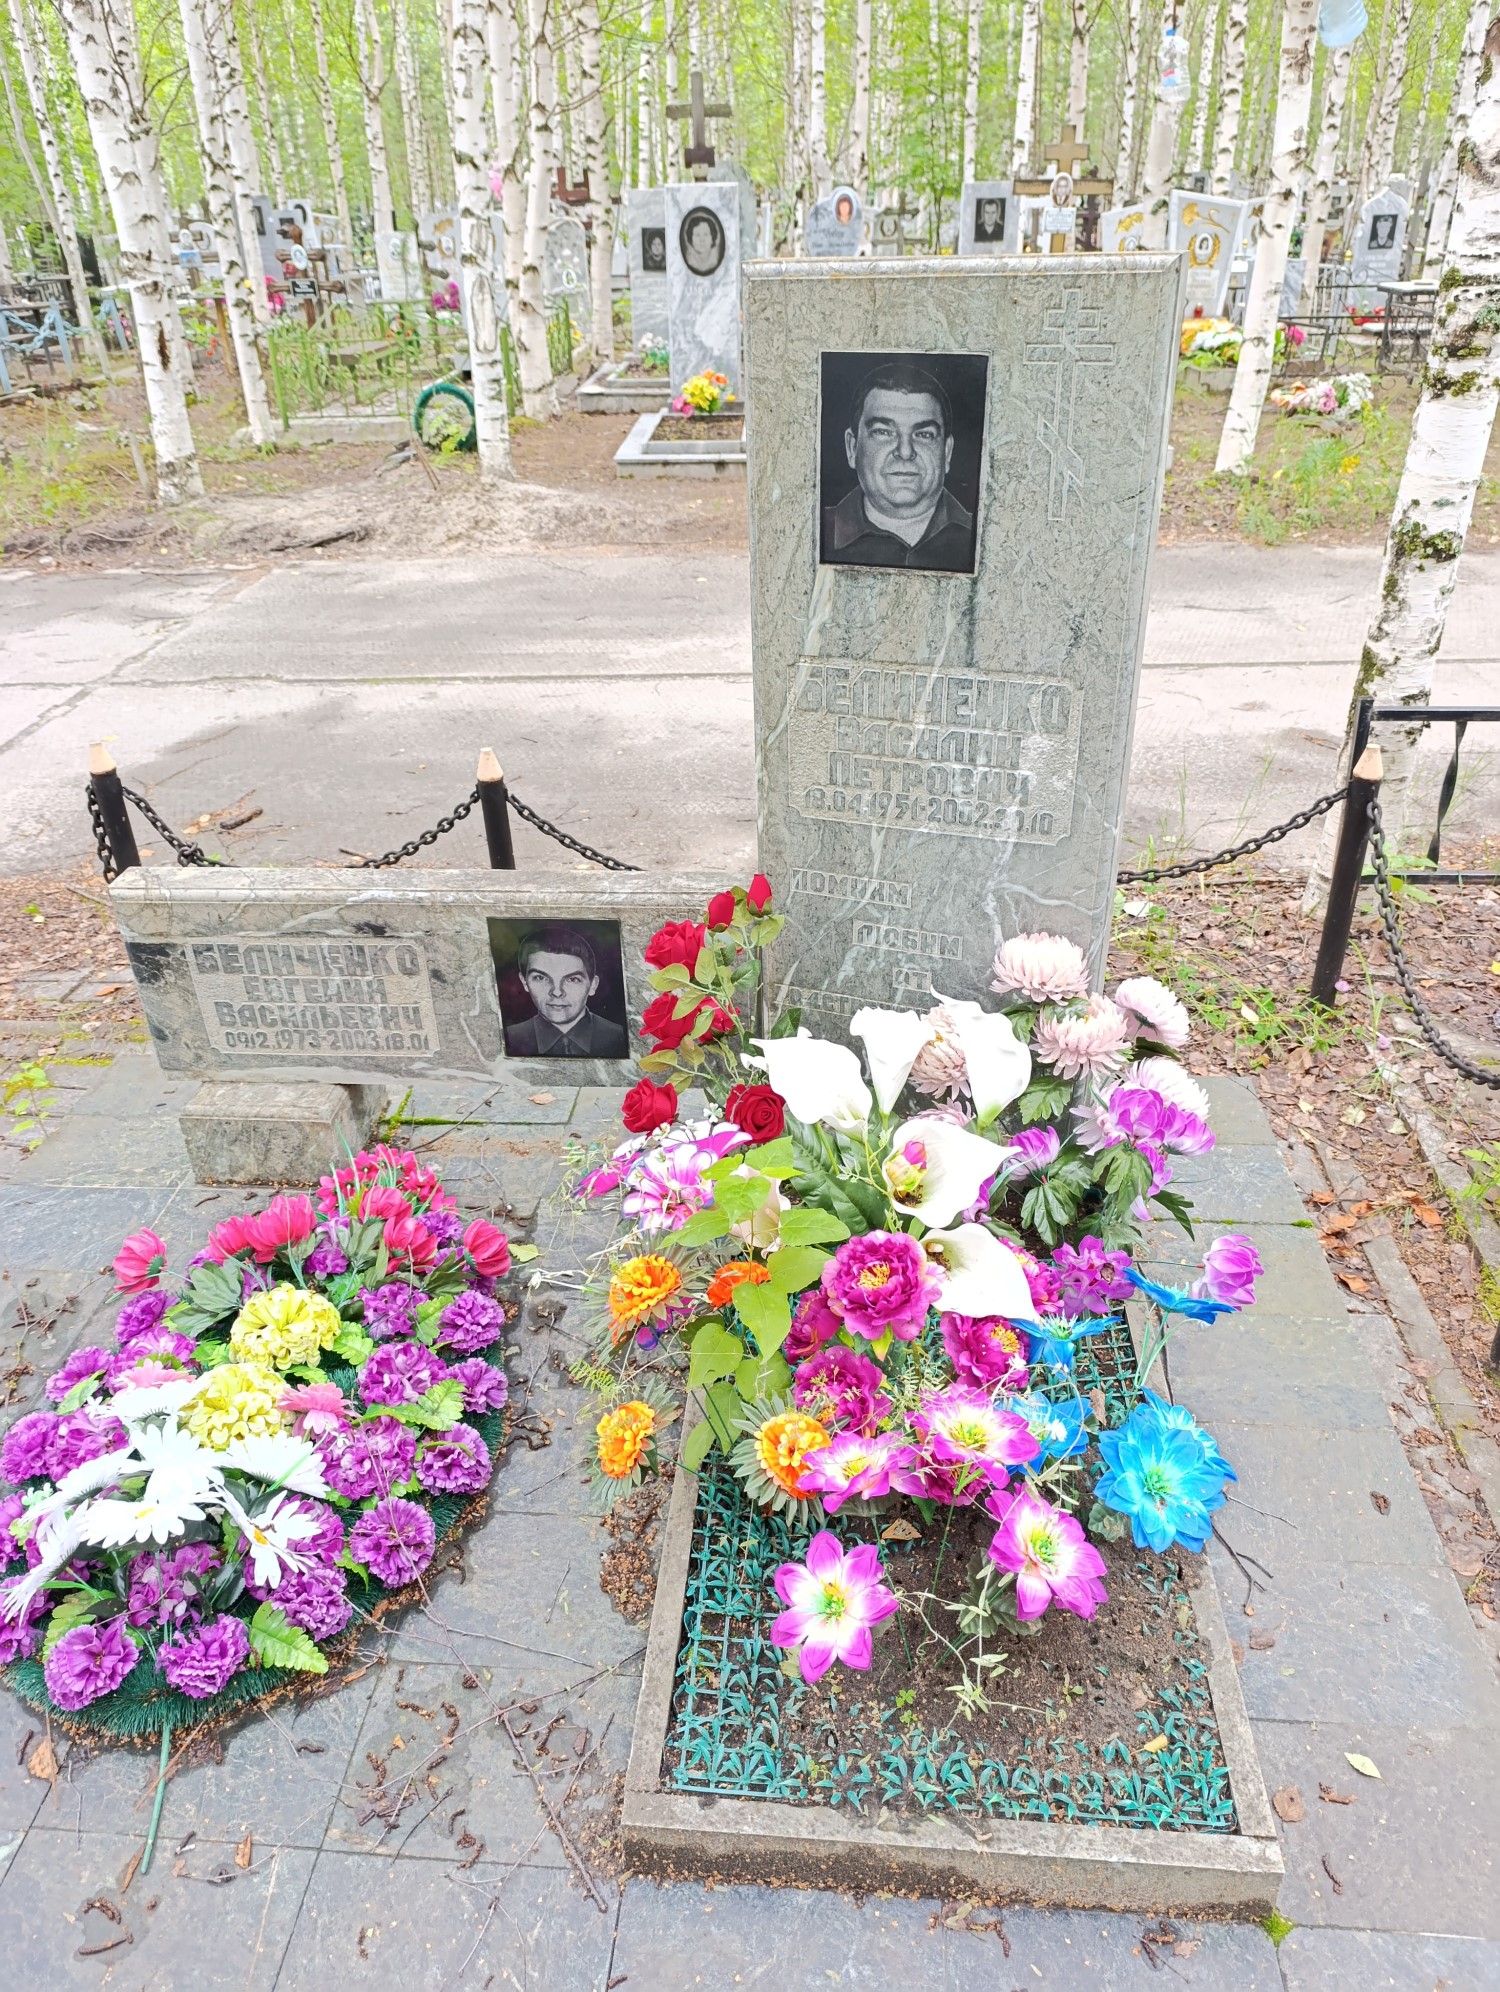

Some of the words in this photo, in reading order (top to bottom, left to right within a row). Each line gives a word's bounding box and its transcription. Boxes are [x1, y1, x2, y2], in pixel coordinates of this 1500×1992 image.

[797, 664, 1071, 734] БЕЛИЧЕНКО
[829, 751, 1031, 806] ПЕТРОВИЧ
[793, 868, 908, 906] ПОМНИМ
[857, 924, 959, 956] ЛЮБИМ
[192, 943, 421, 976] БЕЛИЧЕНКО
[214, 1001, 424, 1030] ВАСИЛЬЕВИЧ
